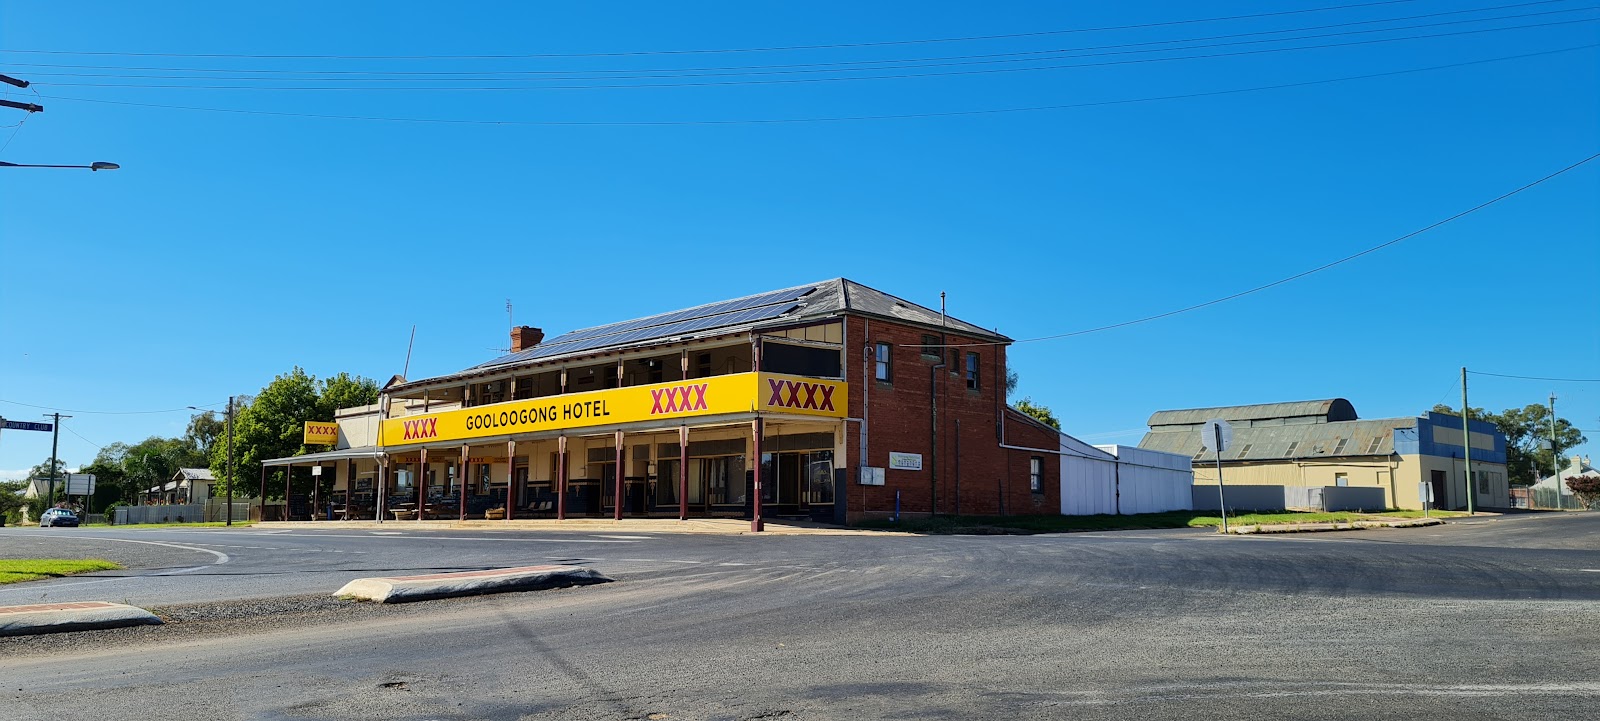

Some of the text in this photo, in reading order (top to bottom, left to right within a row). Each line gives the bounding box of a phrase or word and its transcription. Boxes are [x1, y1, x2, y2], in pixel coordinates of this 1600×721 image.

[650, 383, 708, 415] XXXX
[767, 378, 836, 412] XXXX
[6, 421, 48, 431] COUNTRY CLUB
[466, 401, 610, 430] GOOLOOGONG HOTEL
[308, 425, 337, 436] XXXX
[403, 418, 438, 440] XXXX
